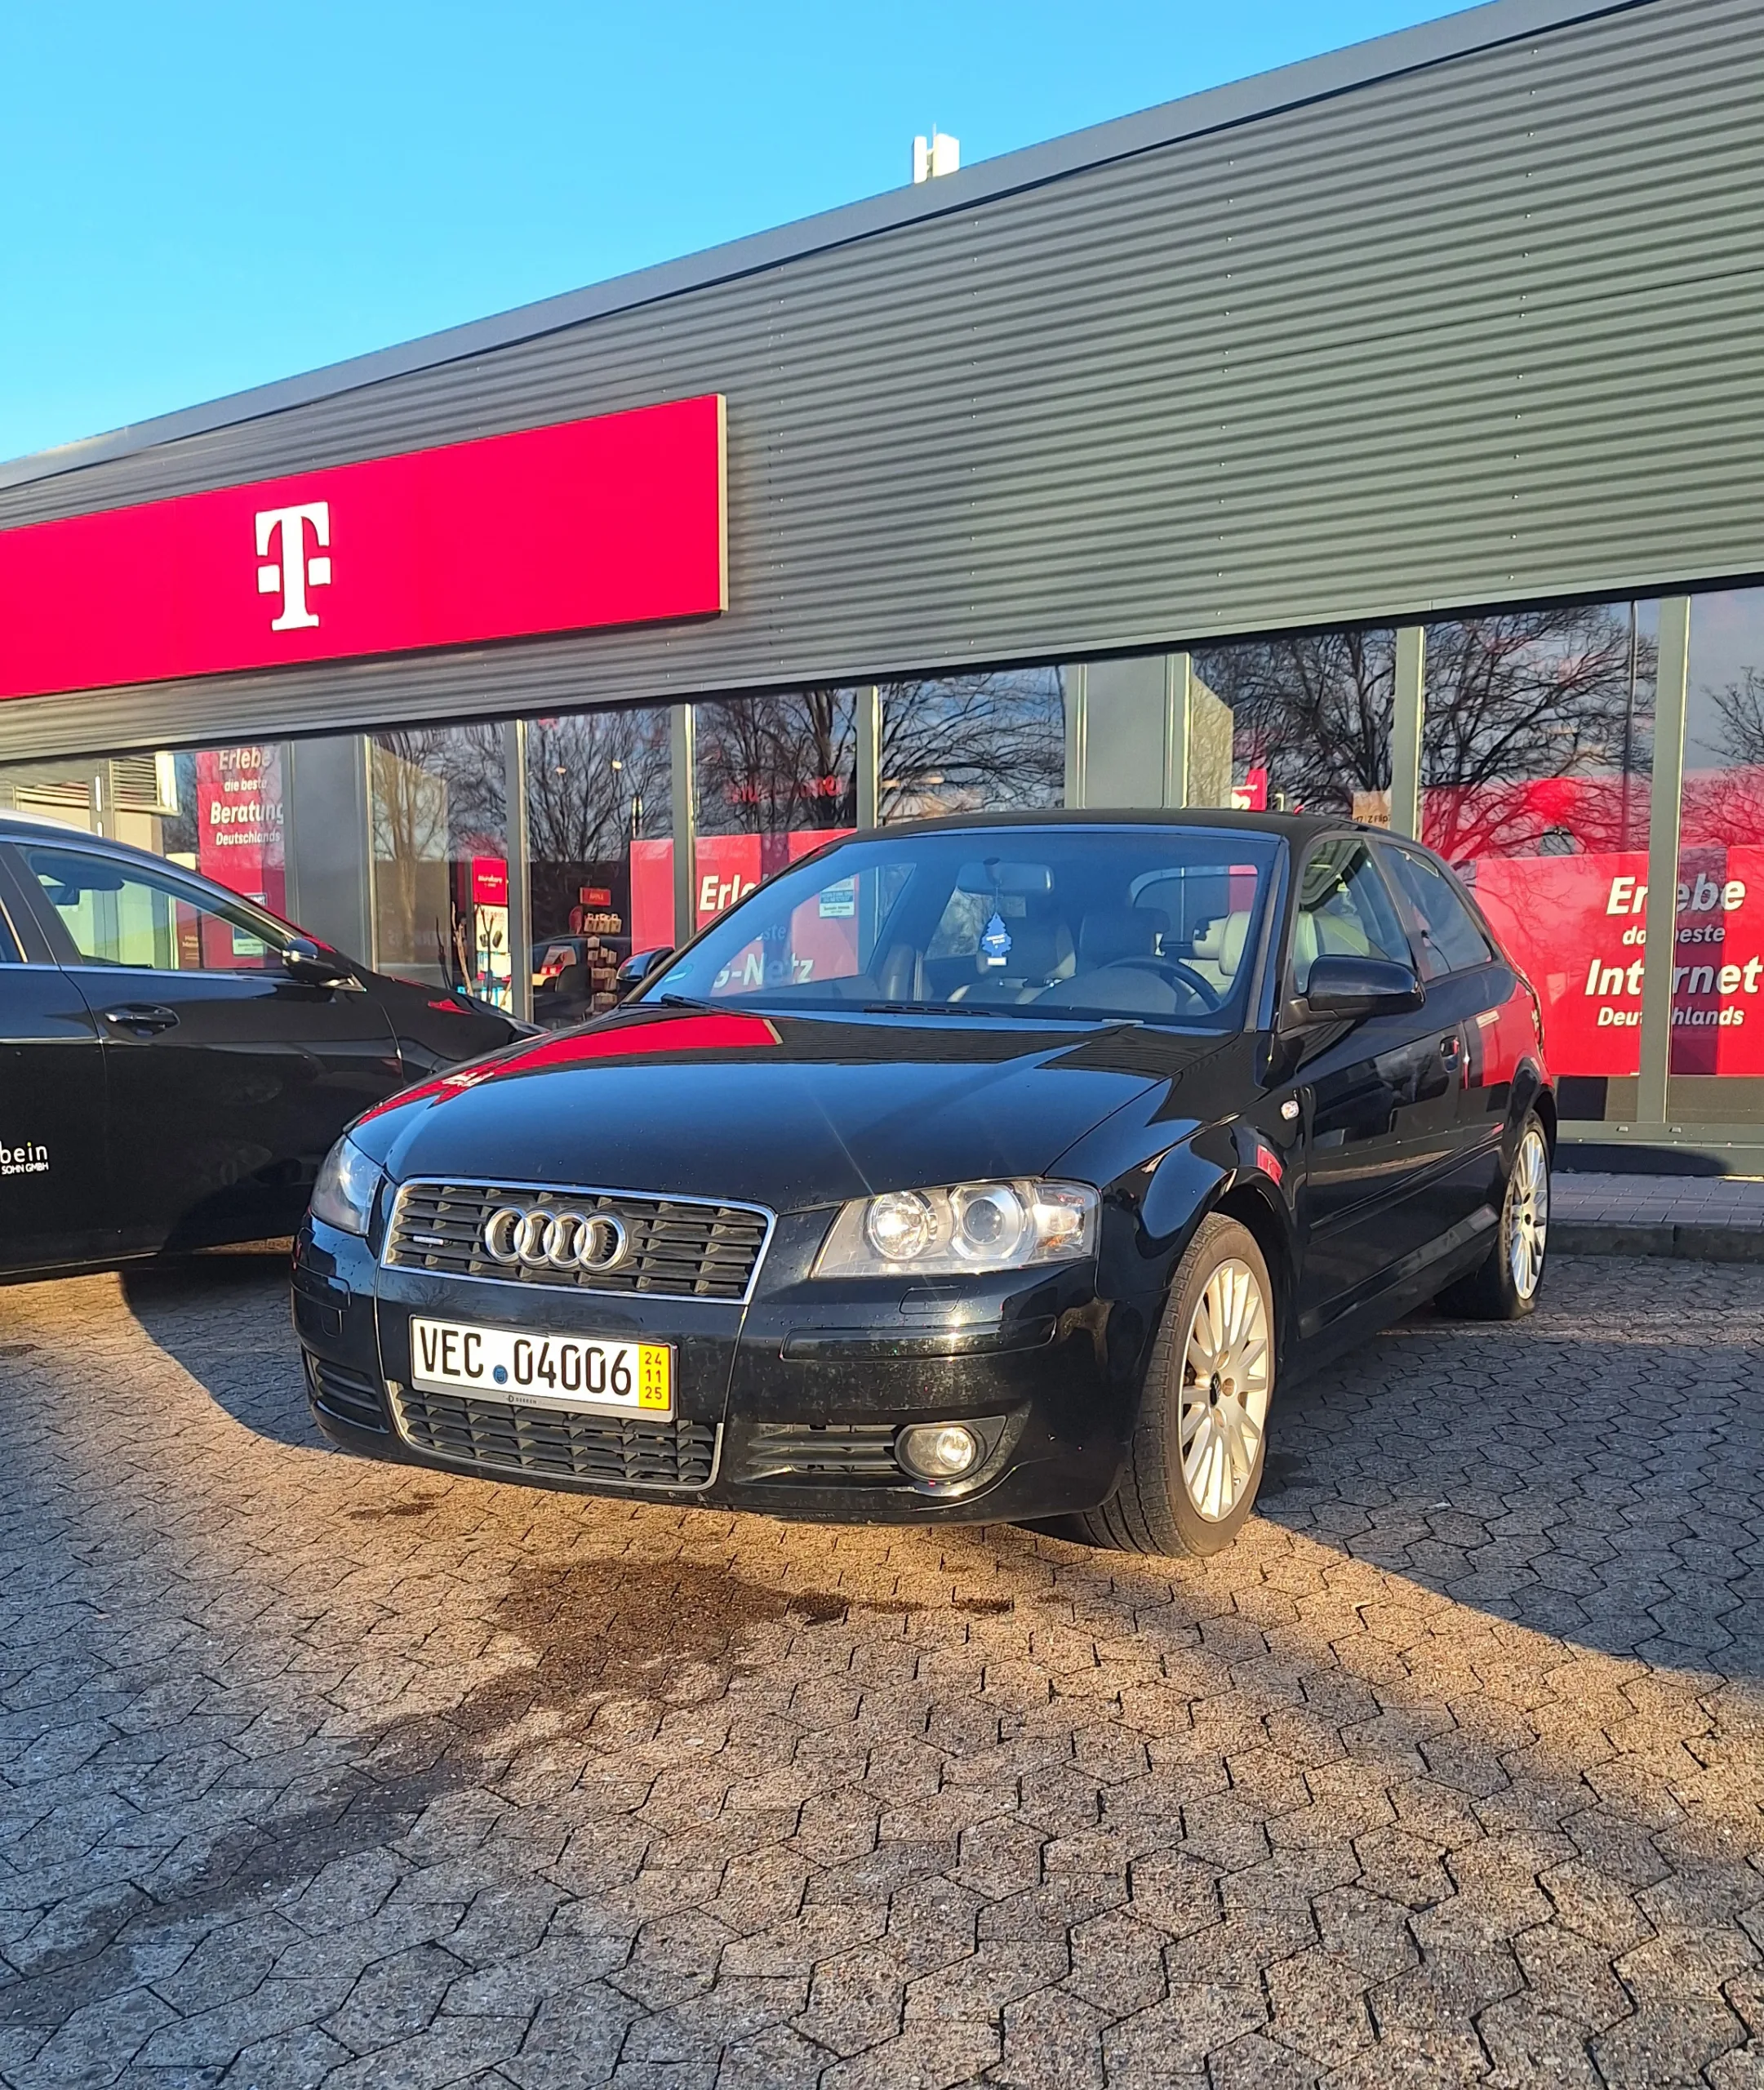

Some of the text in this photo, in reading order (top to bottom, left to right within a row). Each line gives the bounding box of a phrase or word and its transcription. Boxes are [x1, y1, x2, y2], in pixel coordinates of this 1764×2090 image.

[255, 500, 332, 631] T
[219, 746, 273, 772] Erlebe
[224, 777, 268, 793] die beste
[210, 800, 284, 825] Beratung
[216, 828, 281, 846] Deutschlands
[1606, 873, 1746, 915] Erebe
[1622, 926, 1646, 945] da
[1584, 954, 1764, 995] Intrnet
[1597, 1006, 1745, 1027] Deuhlands
[1, 1162, 49, 1175] SOHN GMBH
[420, 1326, 632, 1396] VEC 04006
[644, 1351, 662, 1366] 24
[644, 1368, 661, 1383] 11
[644, 1386, 663, 1400] 25
